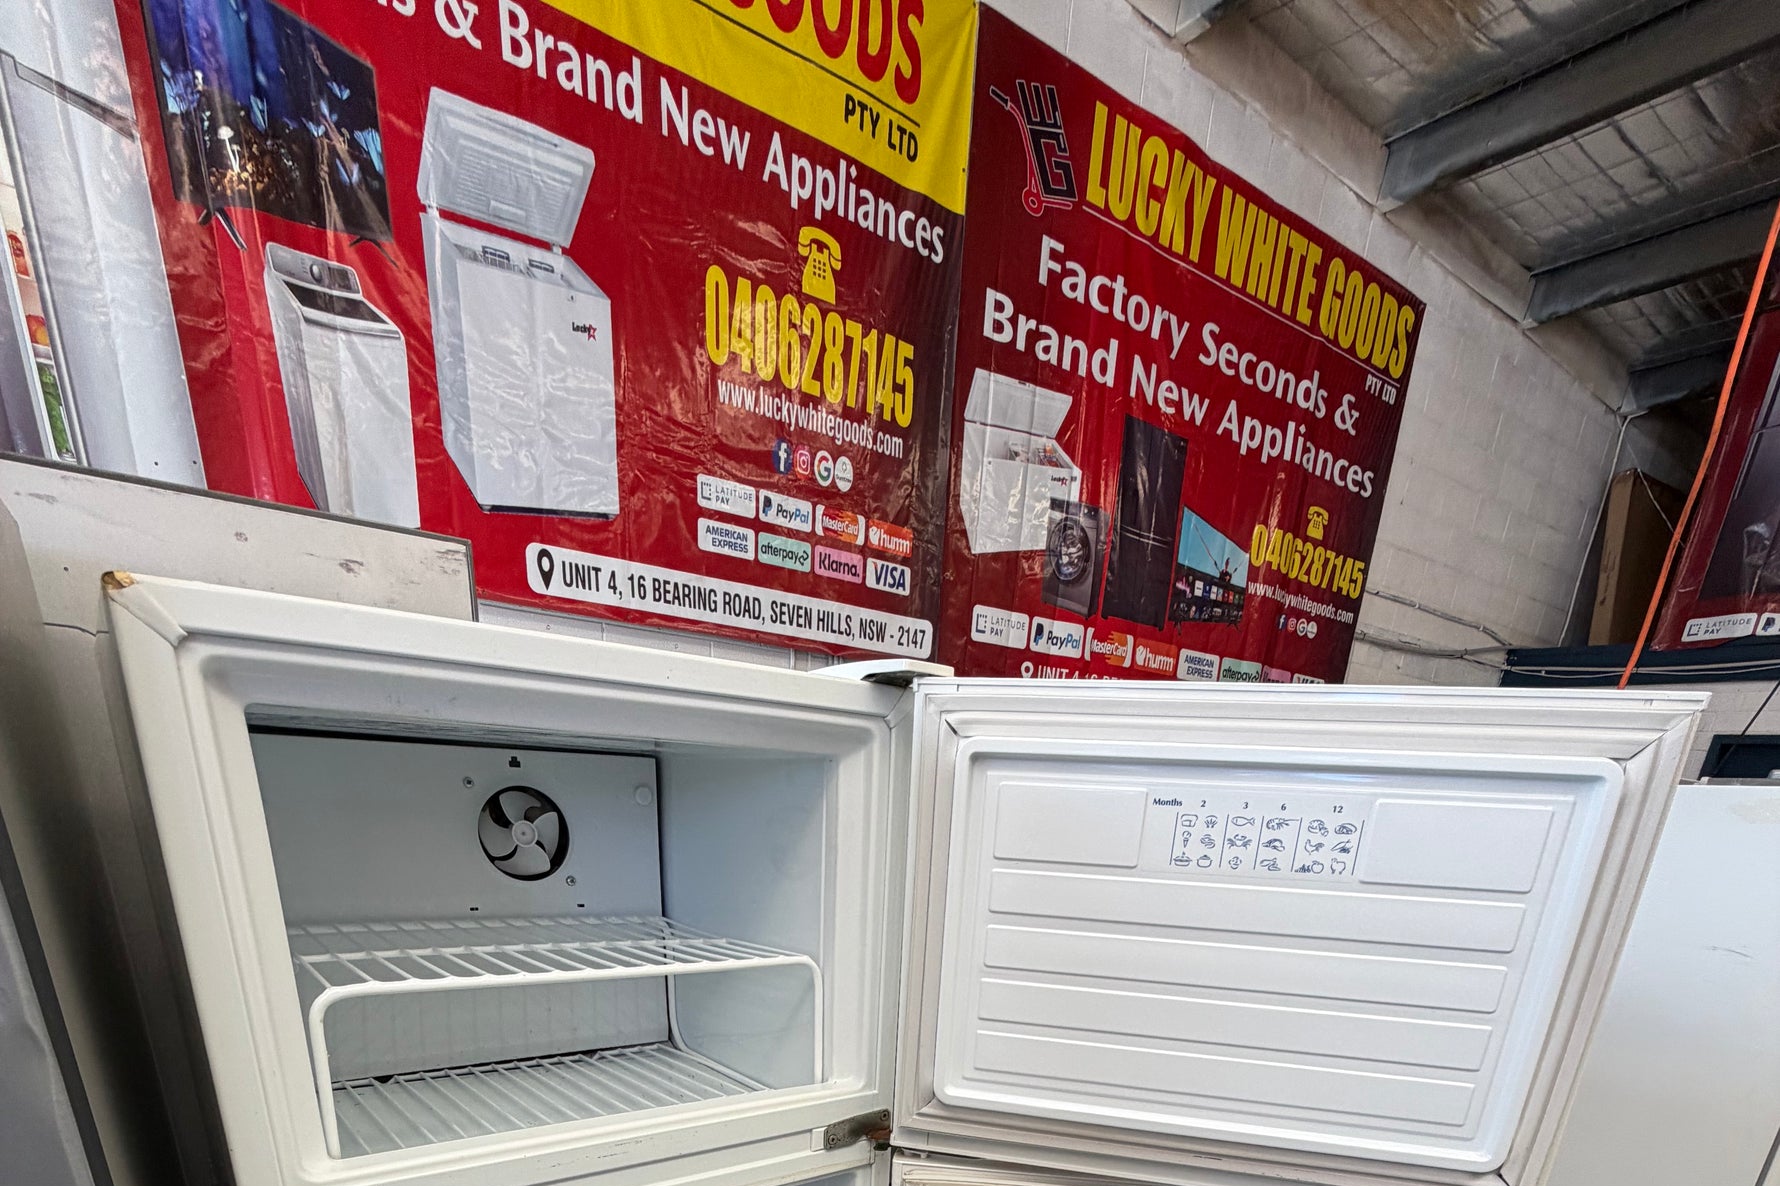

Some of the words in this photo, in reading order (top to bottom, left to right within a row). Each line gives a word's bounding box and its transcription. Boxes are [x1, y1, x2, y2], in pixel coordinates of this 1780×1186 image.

[434, 0, 482, 50] &
[499, 0, 643, 125] Brand
[660, 77, 751, 171] New
[761, 131, 944, 264] Appliances
[844, 93, 880, 139] PTY
[887, 119, 919, 163] LTD
[1085, 100, 1217, 263] LUCKY
[1214, 183, 1322, 327] WHITE
[1319, 257, 1415, 379] GOODS
[705, 264, 915, 428] 0406287145
[1038, 234, 1190, 360] Factory
[1198, 322, 1328, 419] Seconds
[1334, 394, 1361, 436] &
[983, 287, 1119, 388] Brand
[1129, 353, 1210, 427] New
[1216, 399, 1374, 498] Appliances
[1365, 373, 1382, 397] PTY
[1381, 383, 1397, 405] LTD
[717, 379, 904, 459] www.luckywhitegoods.com
[715, 484, 753, 502] LATITUDE
[715, 495, 731, 506] PAY
[776, 503, 810, 525] PayPal
[822, 514, 859, 535] MasterCard
[705, 524, 748, 543] AMERICAN
[880, 529, 910, 554] humm
[711, 537, 749, 554] EXPRESS
[760, 543, 801, 565] afterpay
[1250, 524, 1365, 600] 0406287145
[872, 561, 907, 592] VISA
[561, 560, 601, 592] UNIT
[607, 570, 623, 600] 4,
[627, 573, 647, 600] 16
[652, 578, 718, 613] BEARING
[722, 591, 765, 626] ROAD,
[770, 600, 812, 630] SEVEN
[816, 608, 855, 641] HILLS,
[859, 618, 887, 643] NSW
[897, 625, 926, 650] 2147
[990, 616, 1026, 631] LATITUDE
[990, 628, 1004, 637] PAY
[1703, 628, 1722, 636] PAY
[1706, 618, 1753, 629] LATITUDE
[1046, 630, 1082, 650] PayPal
[1090, 638, 1128, 657] MasterCard
[1144, 647, 1174, 672] humm
[1183, 654, 1215, 669] AMERICAN
[1186, 665, 1214, 679] EXPRESS
[1152, 798, 1183, 808] Months
[1200, 800, 1207, 808] 2
[1242, 802, 1249, 810] 3
[1280, 803, 1287, 811] 6
[1332, 805, 1343, 814] 12
